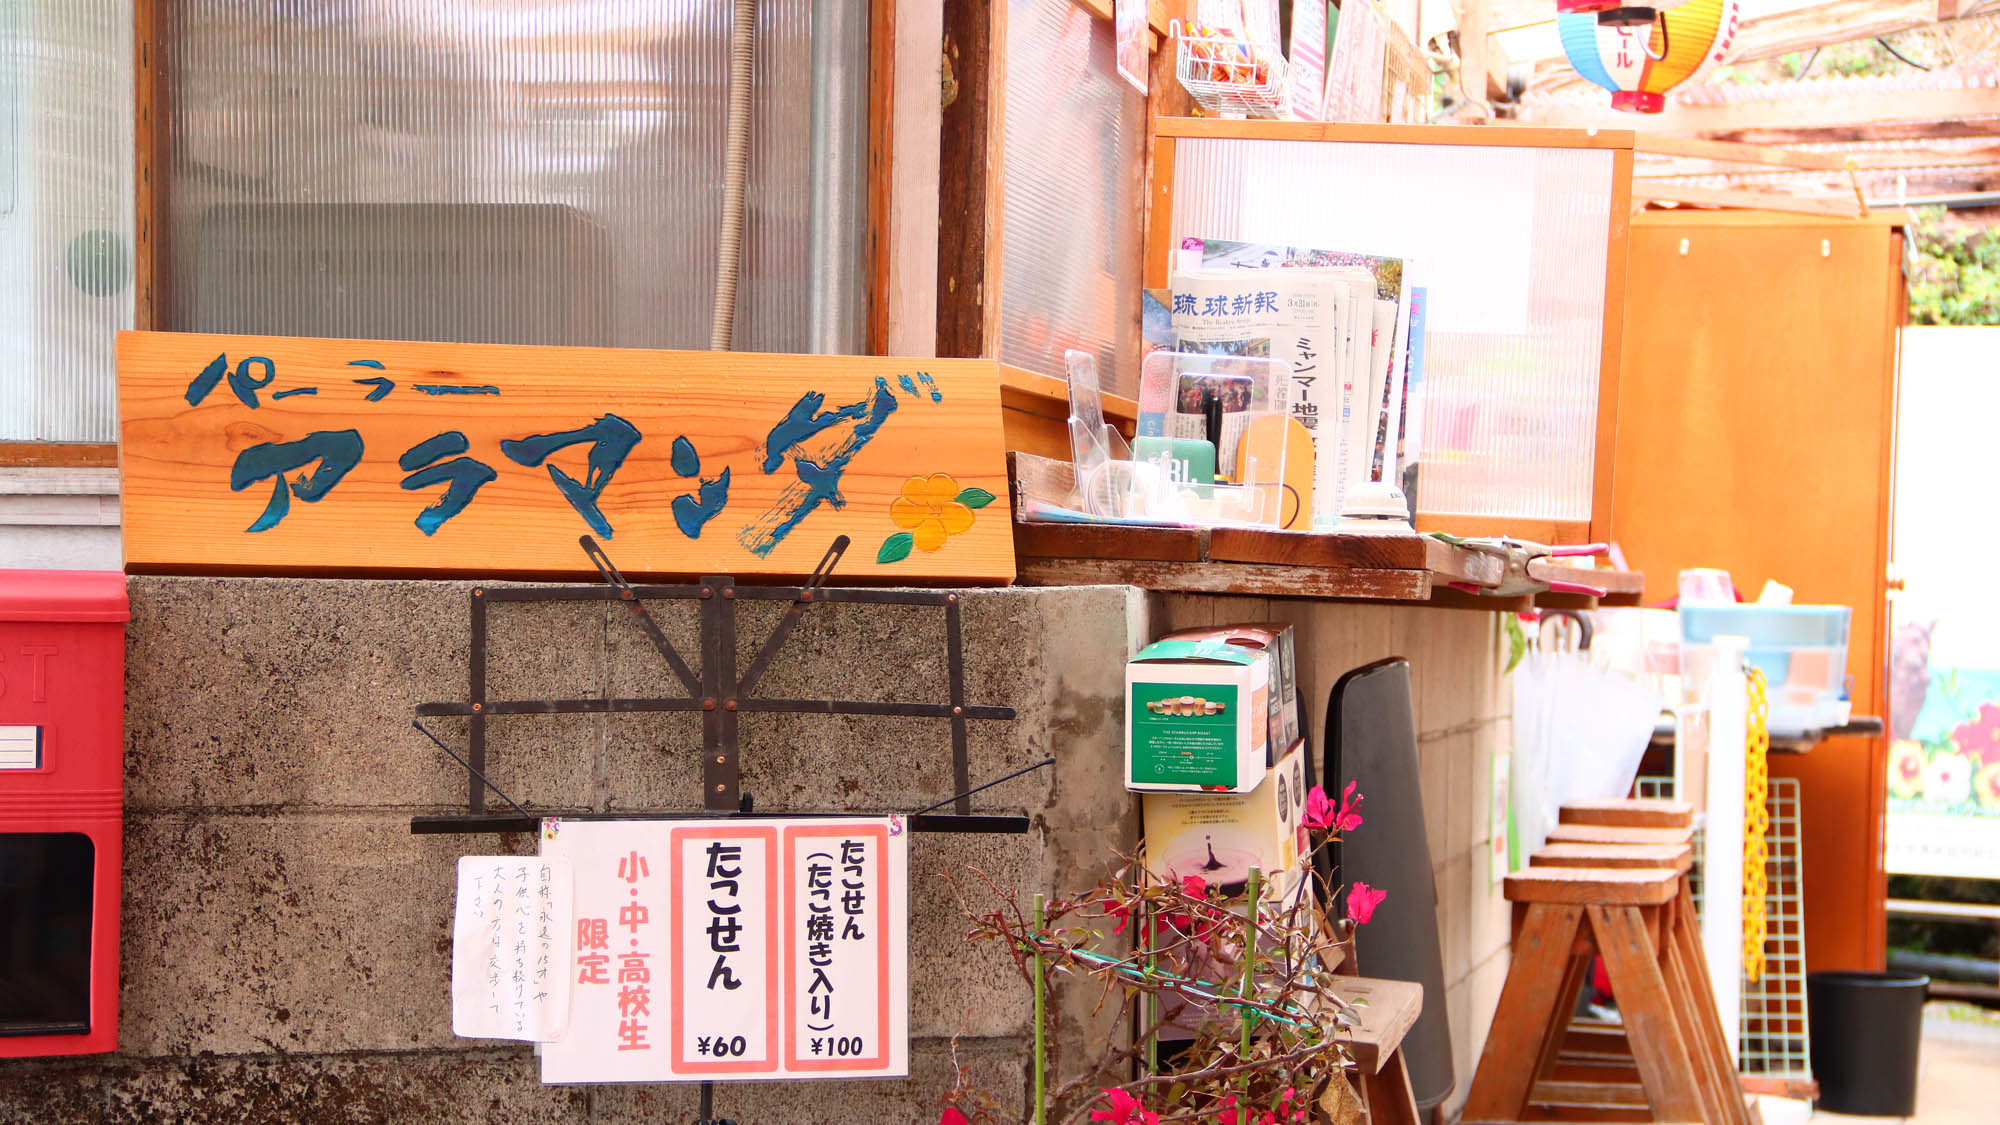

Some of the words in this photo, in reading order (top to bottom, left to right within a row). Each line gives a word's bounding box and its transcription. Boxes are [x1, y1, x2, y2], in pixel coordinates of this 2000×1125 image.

[1172, 290, 1279, 317] 琉球新報
[185, 352, 500, 408] パーラー
[230, 371, 943, 559] アラマンダ
[705, 841, 743, 991] たこせん
[840, 839, 865, 940] たこせん
[576, 917, 611, 986] 限定
[697, 1035, 747, 1058] ¥60
[810, 1036, 864, 1057] ¥100
